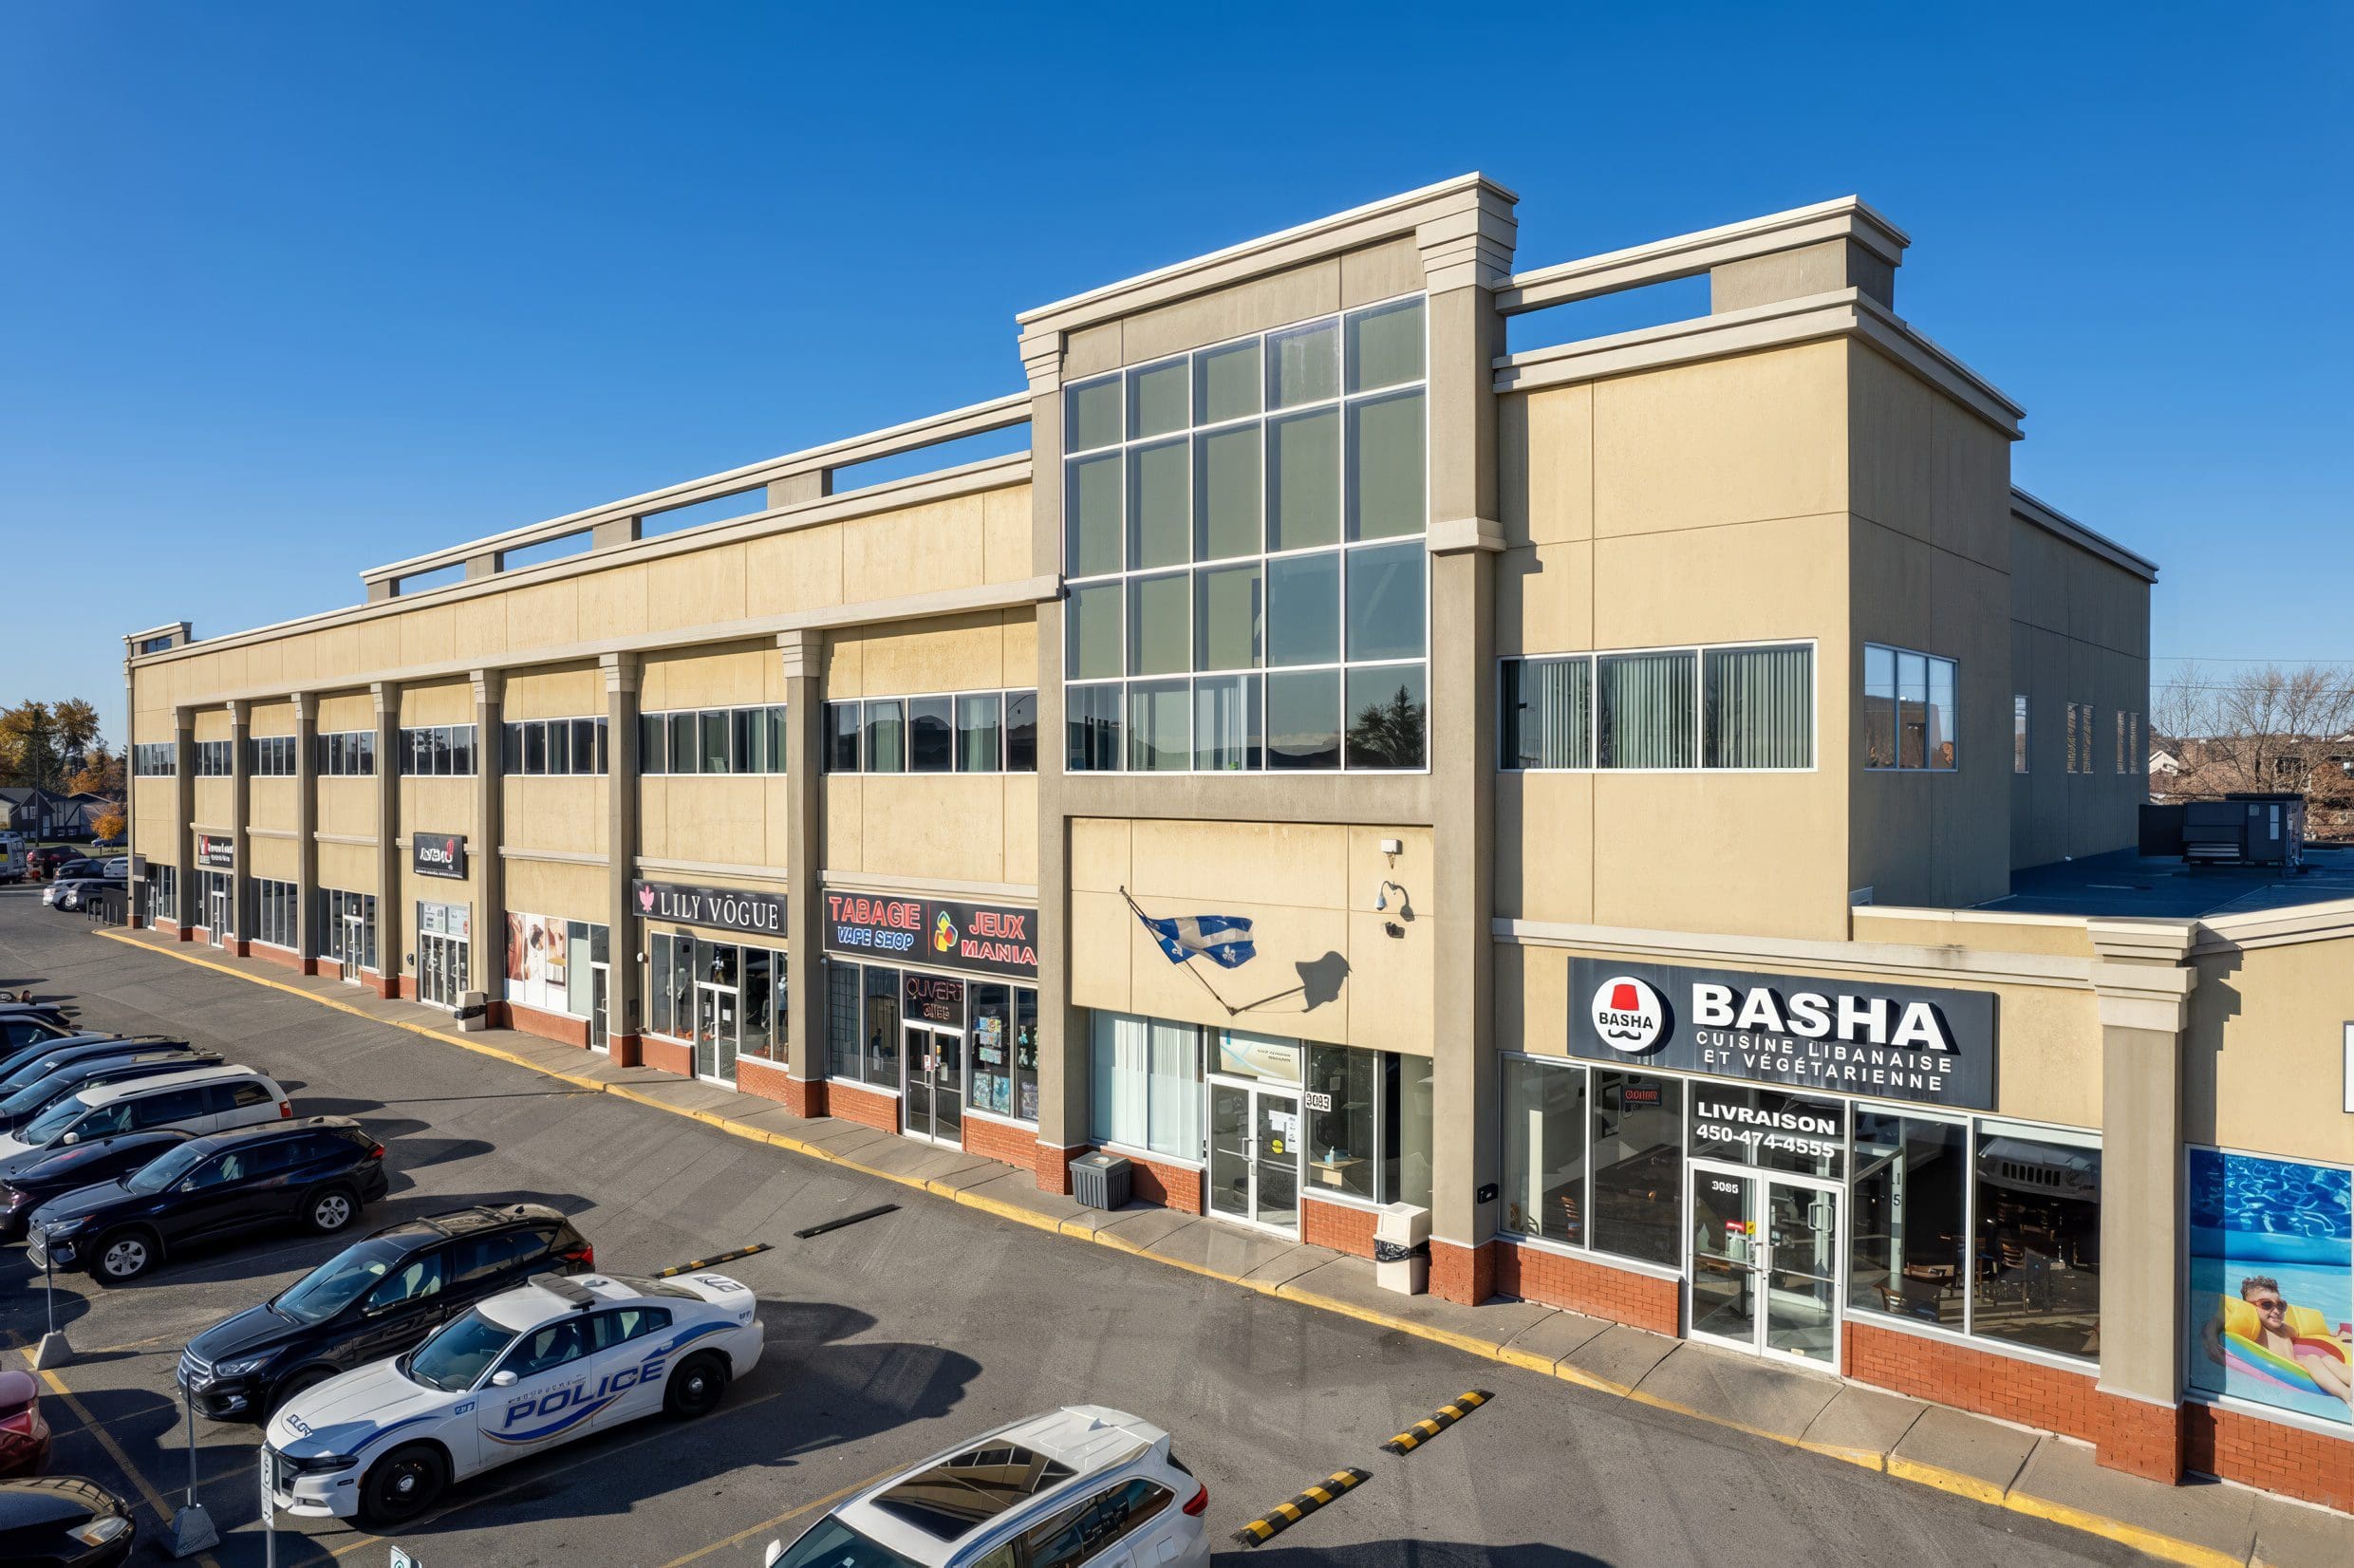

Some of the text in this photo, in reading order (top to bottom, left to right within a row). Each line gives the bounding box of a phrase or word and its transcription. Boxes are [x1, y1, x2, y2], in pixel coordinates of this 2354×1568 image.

[661, 892, 701, 920] LILY
[837, 925, 914, 951] VAPE SHOP
[968, 911, 1026, 941] JEUX
[961, 939, 1037, 966] MANIA
[1598, 1012, 1653, 1030] BASHA
[1692, 982, 1948, 1051] BASHA
[1696, 1031, 1952, 1073] CUISINE LIBANAISE
[1704, 1049, 1942, 1092] ET VÉGÉTARIENNE
[1697, 1102, 1836, 1135] LIVRAISON
[1696, 1124, 1836, 1158] 450-474-4555
[504, 1358, 666, 1428] POLICE
